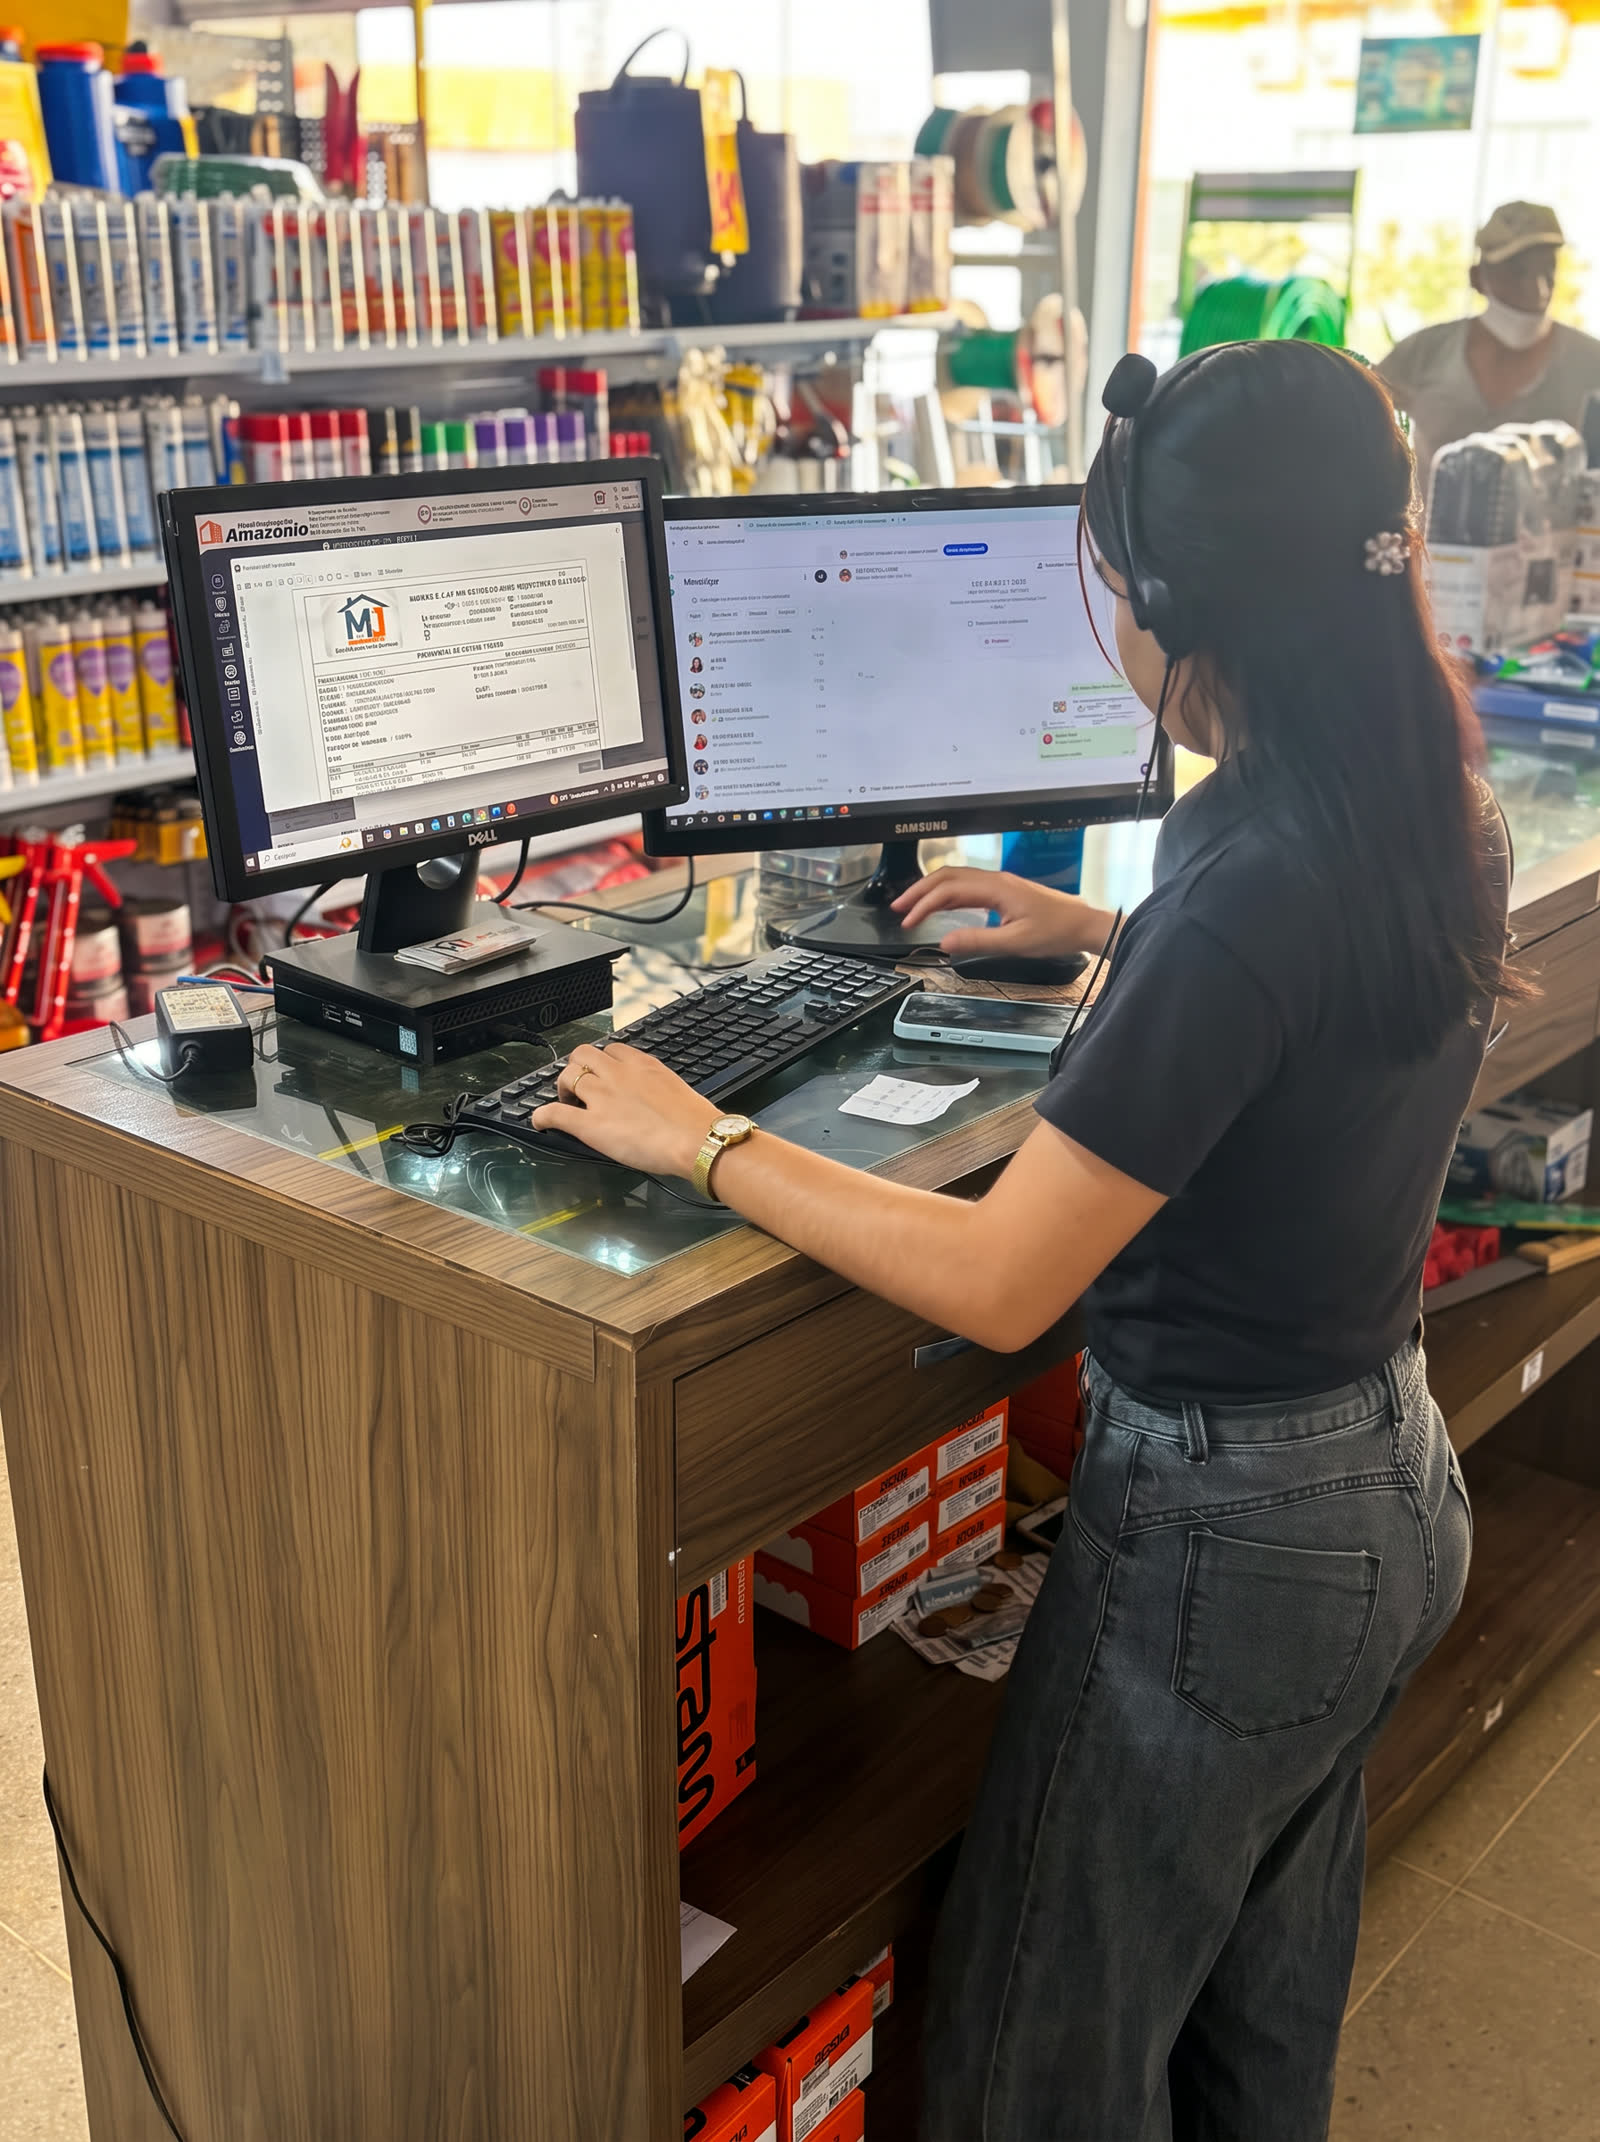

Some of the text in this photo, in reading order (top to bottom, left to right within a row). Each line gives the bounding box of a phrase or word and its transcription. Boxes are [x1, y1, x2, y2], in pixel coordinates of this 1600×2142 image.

[225, 522, 309, 543] Amazonio
[895, 820, 948, 834] SAMSUNG
[468, 829, 498, 846] DELL
